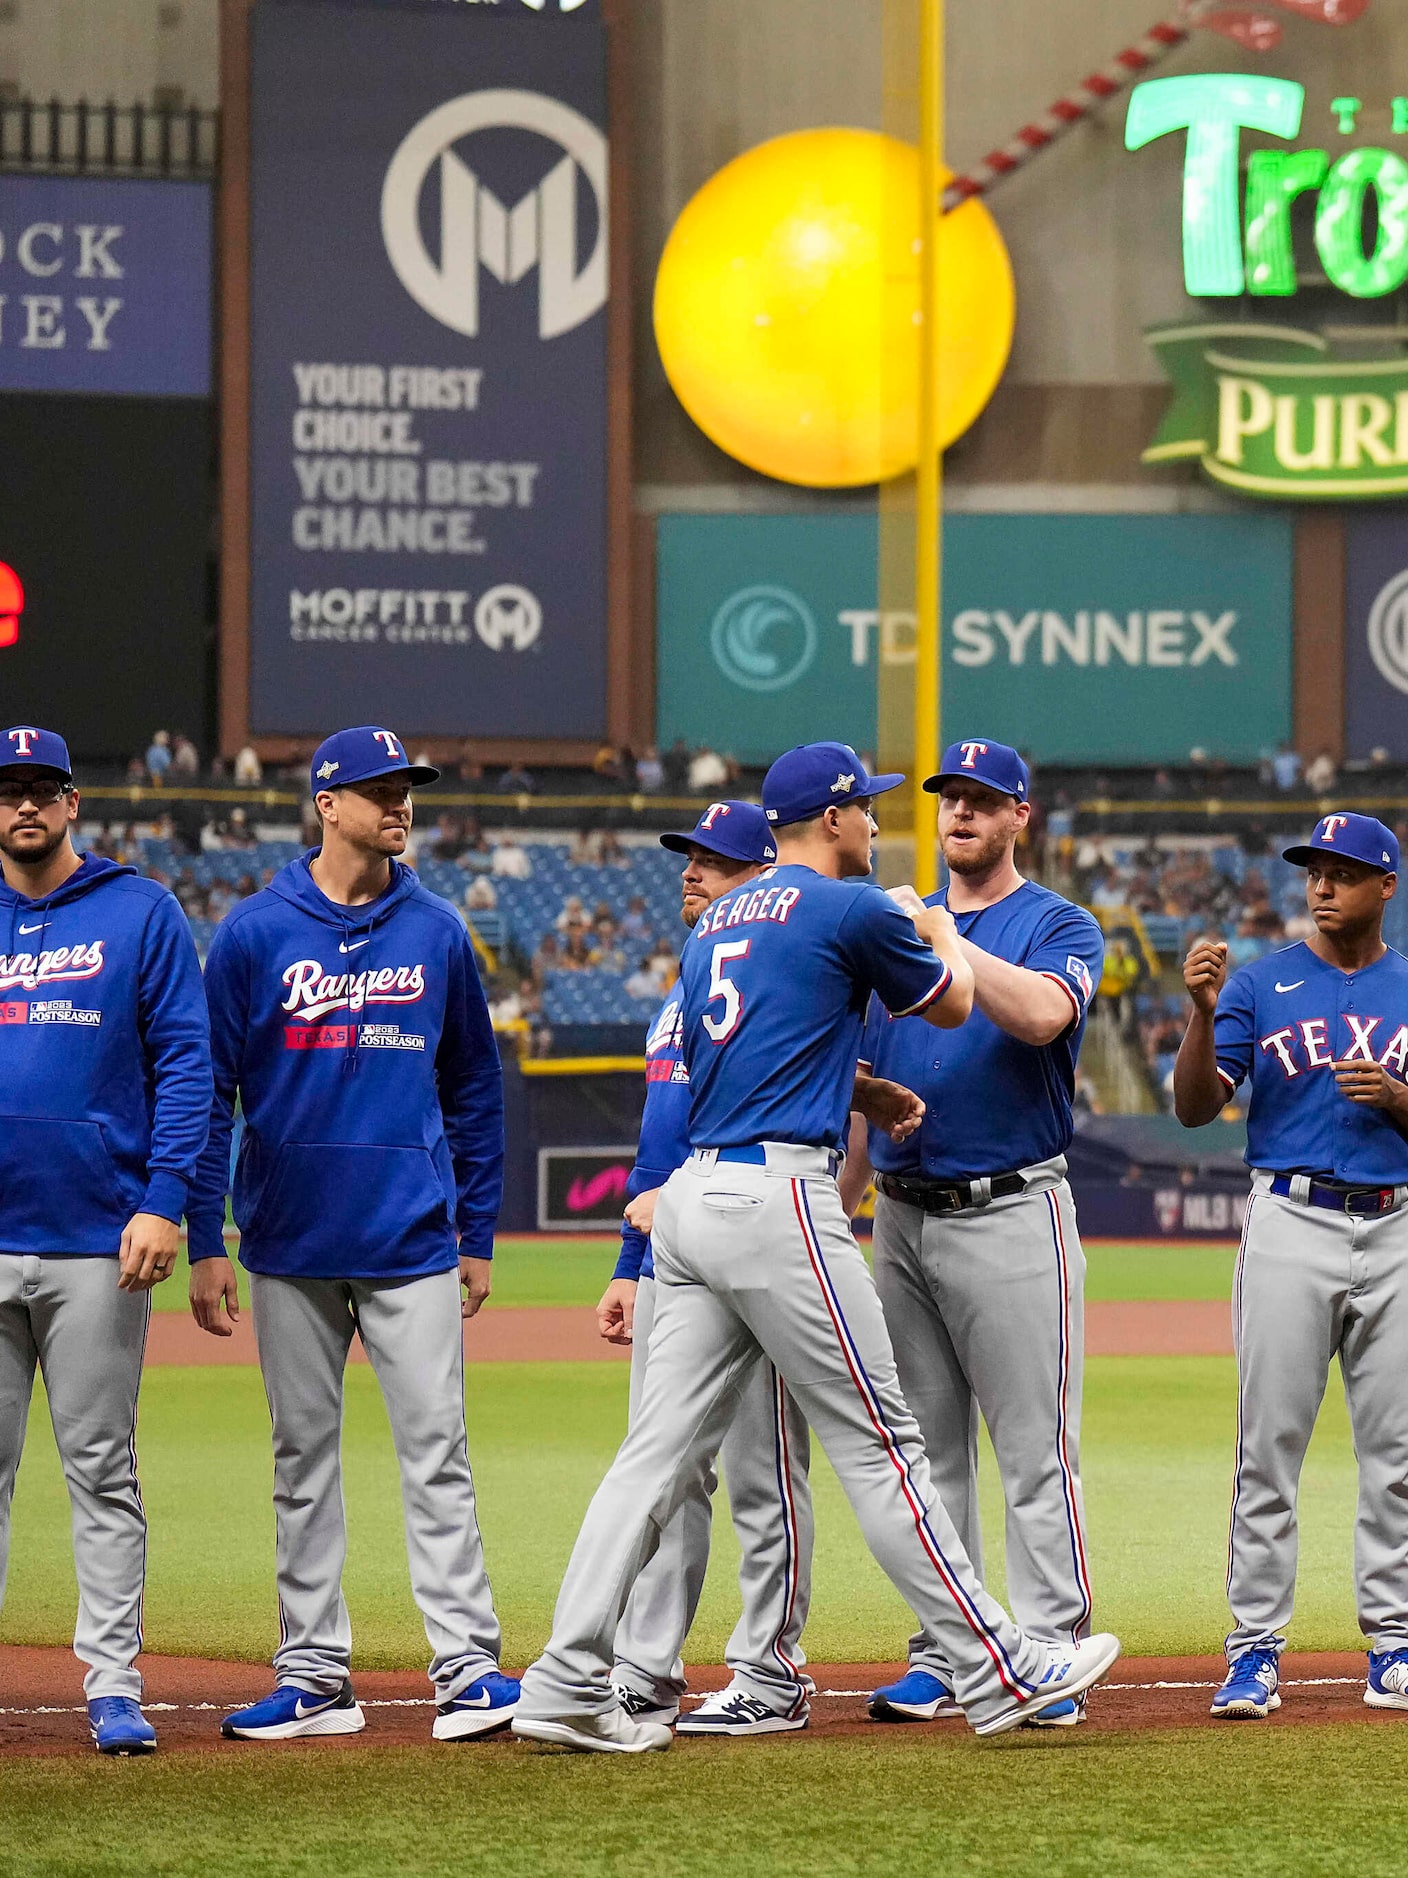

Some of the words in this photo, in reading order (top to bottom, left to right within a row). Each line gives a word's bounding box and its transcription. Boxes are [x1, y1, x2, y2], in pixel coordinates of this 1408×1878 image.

[0, 222, 126, 280] CK
[0, 294, 125, 351] EY
[293, 363, 385, 409] YOUR
[389, 366, 483, 411] FIRST
[293, 410, 422, 454] CHOICE.
[293, 454, 419, 504] YOUR
[425, 458, 540, 508] BEST
[292, 505, 487, 554] CHANCE.
[290, 586, 469, 625] MOFFITT
[952, 609, 1238, 668] SYNNEX
[697, 887, 801, 940] SEAGER
[281, 959, 426, 1024] Rangers
[702, 939, 752, 1045] 5
[30, 1011, 101, 1024] POSTSEASON
[359, 1034, 425, 1048] POSTSEASON
[1183, 1194, 1229, 1231] MLB
